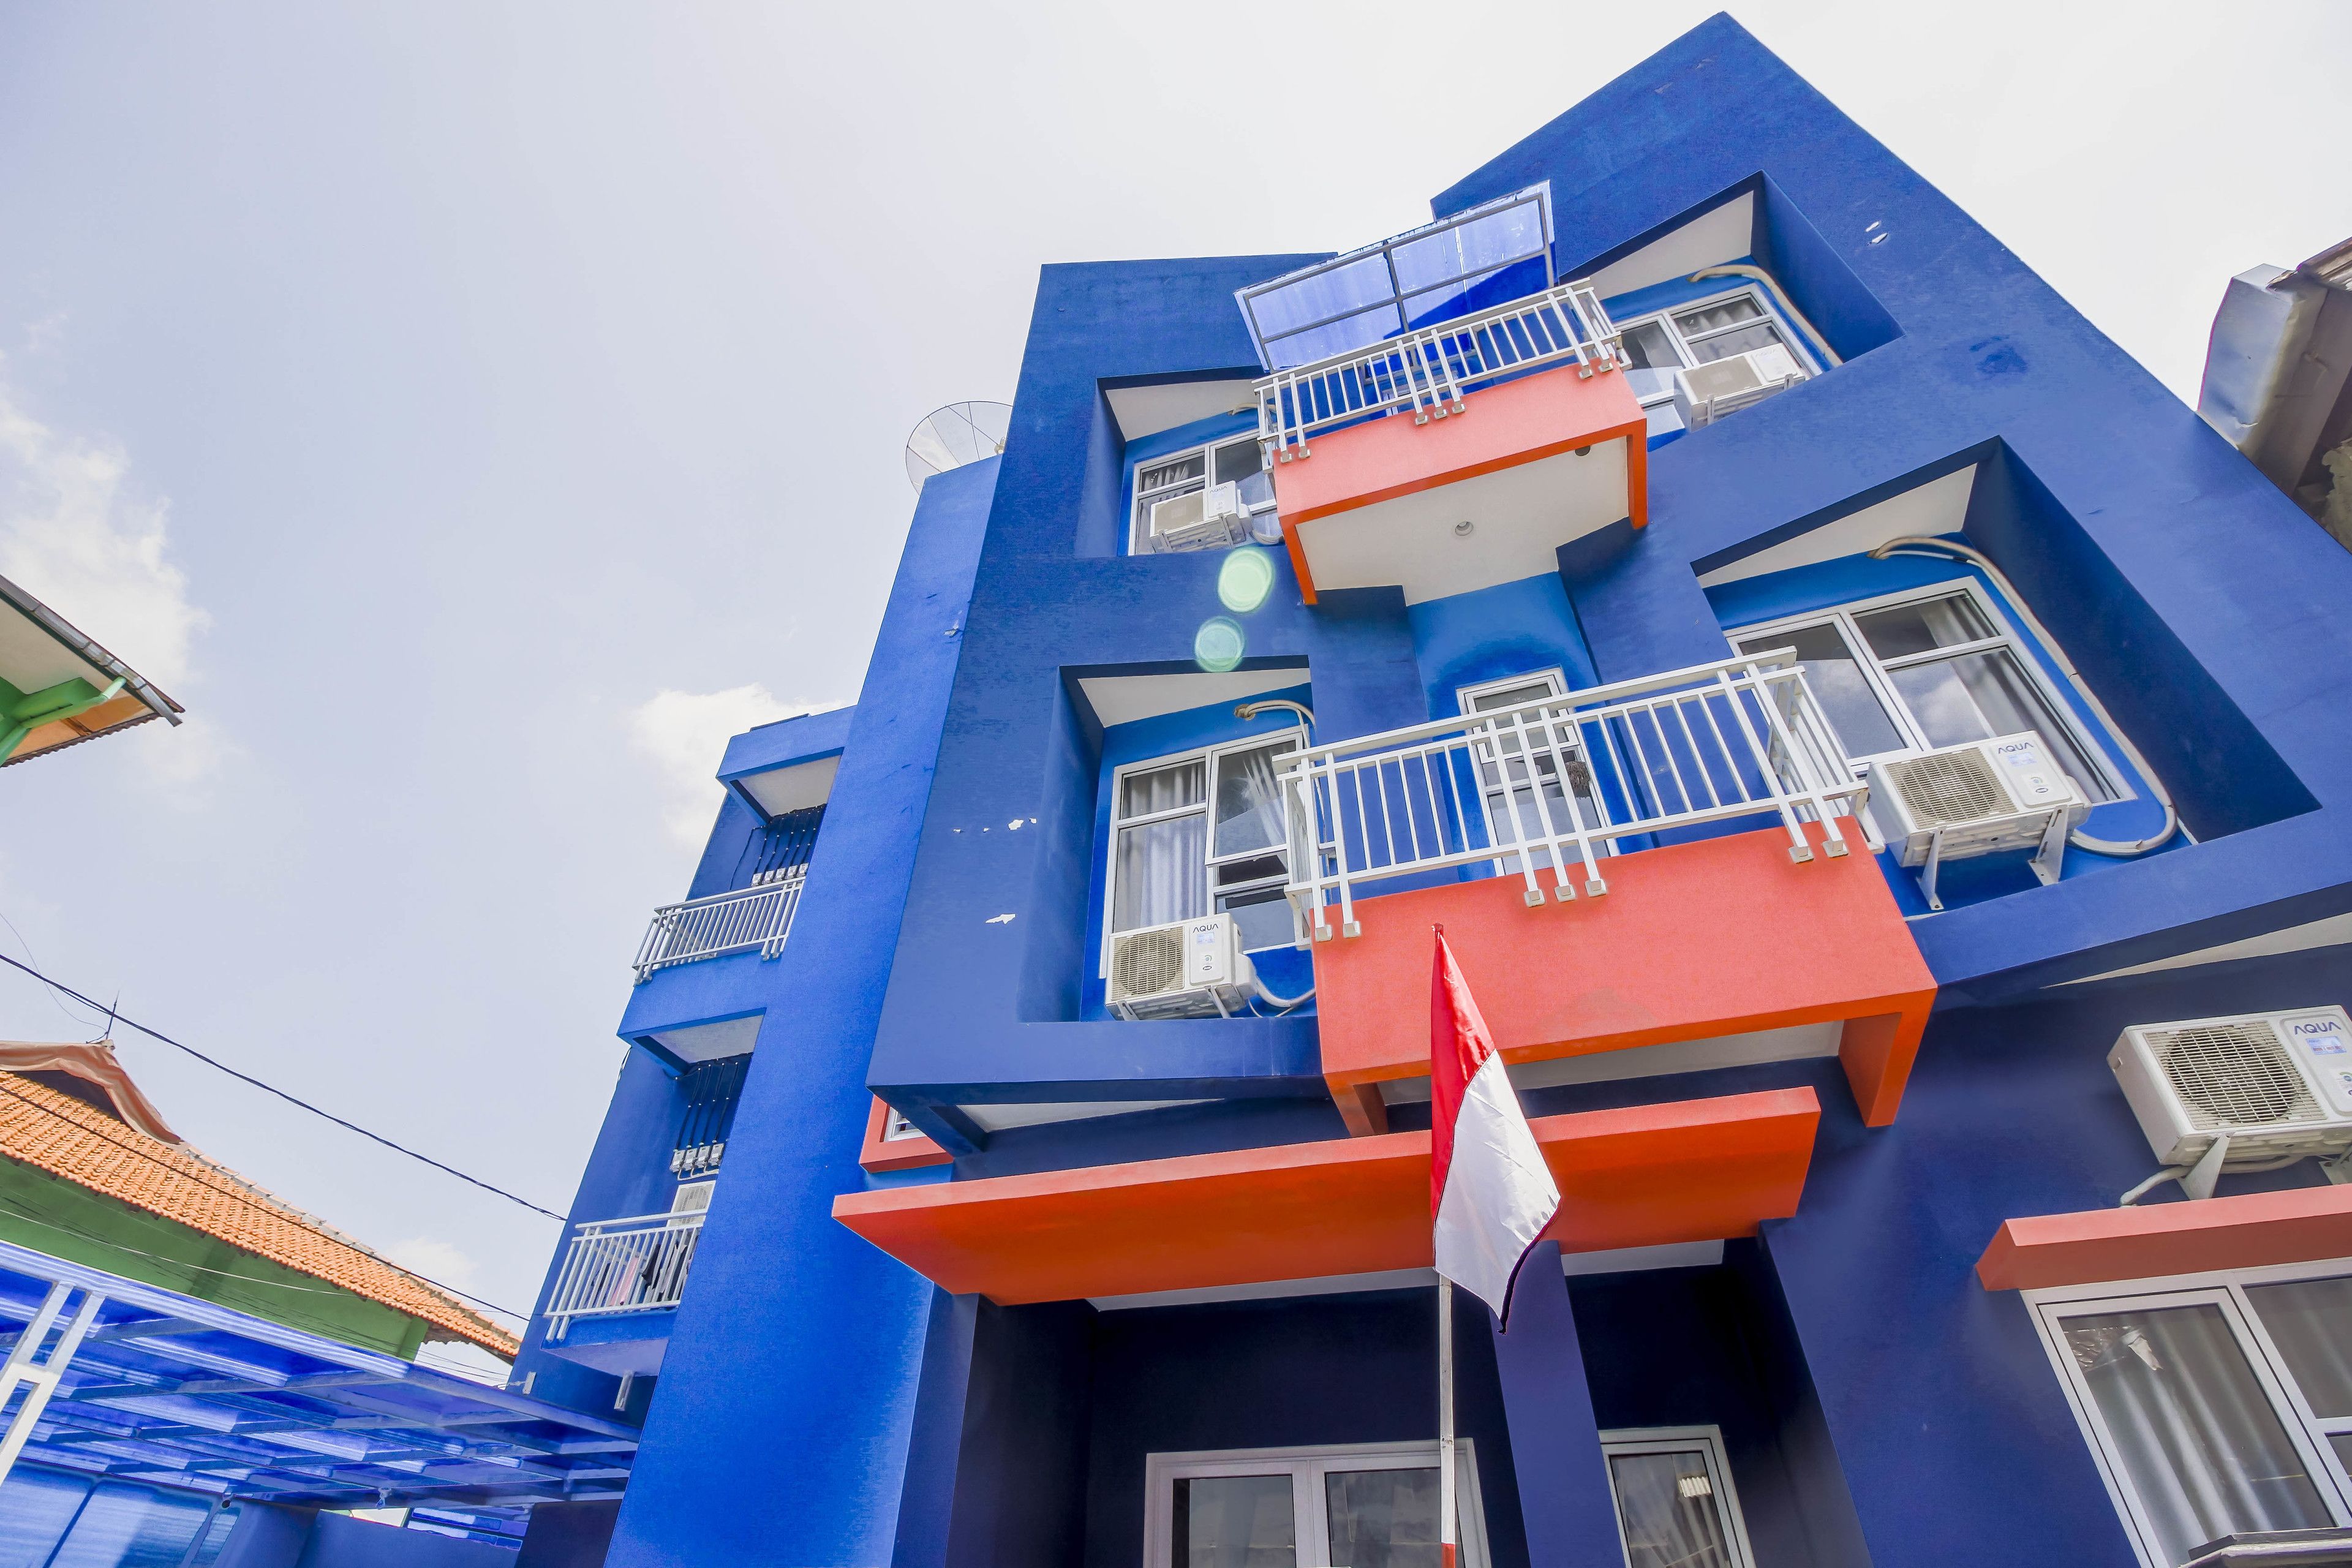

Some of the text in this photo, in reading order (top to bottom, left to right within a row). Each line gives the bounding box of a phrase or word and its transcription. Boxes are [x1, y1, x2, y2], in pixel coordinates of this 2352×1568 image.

[1998, 742, 2034, 754] AQUA
[1193, 923, 1219, 933] AQUA
[2294, 1021, 2342, 1035] AQUA
